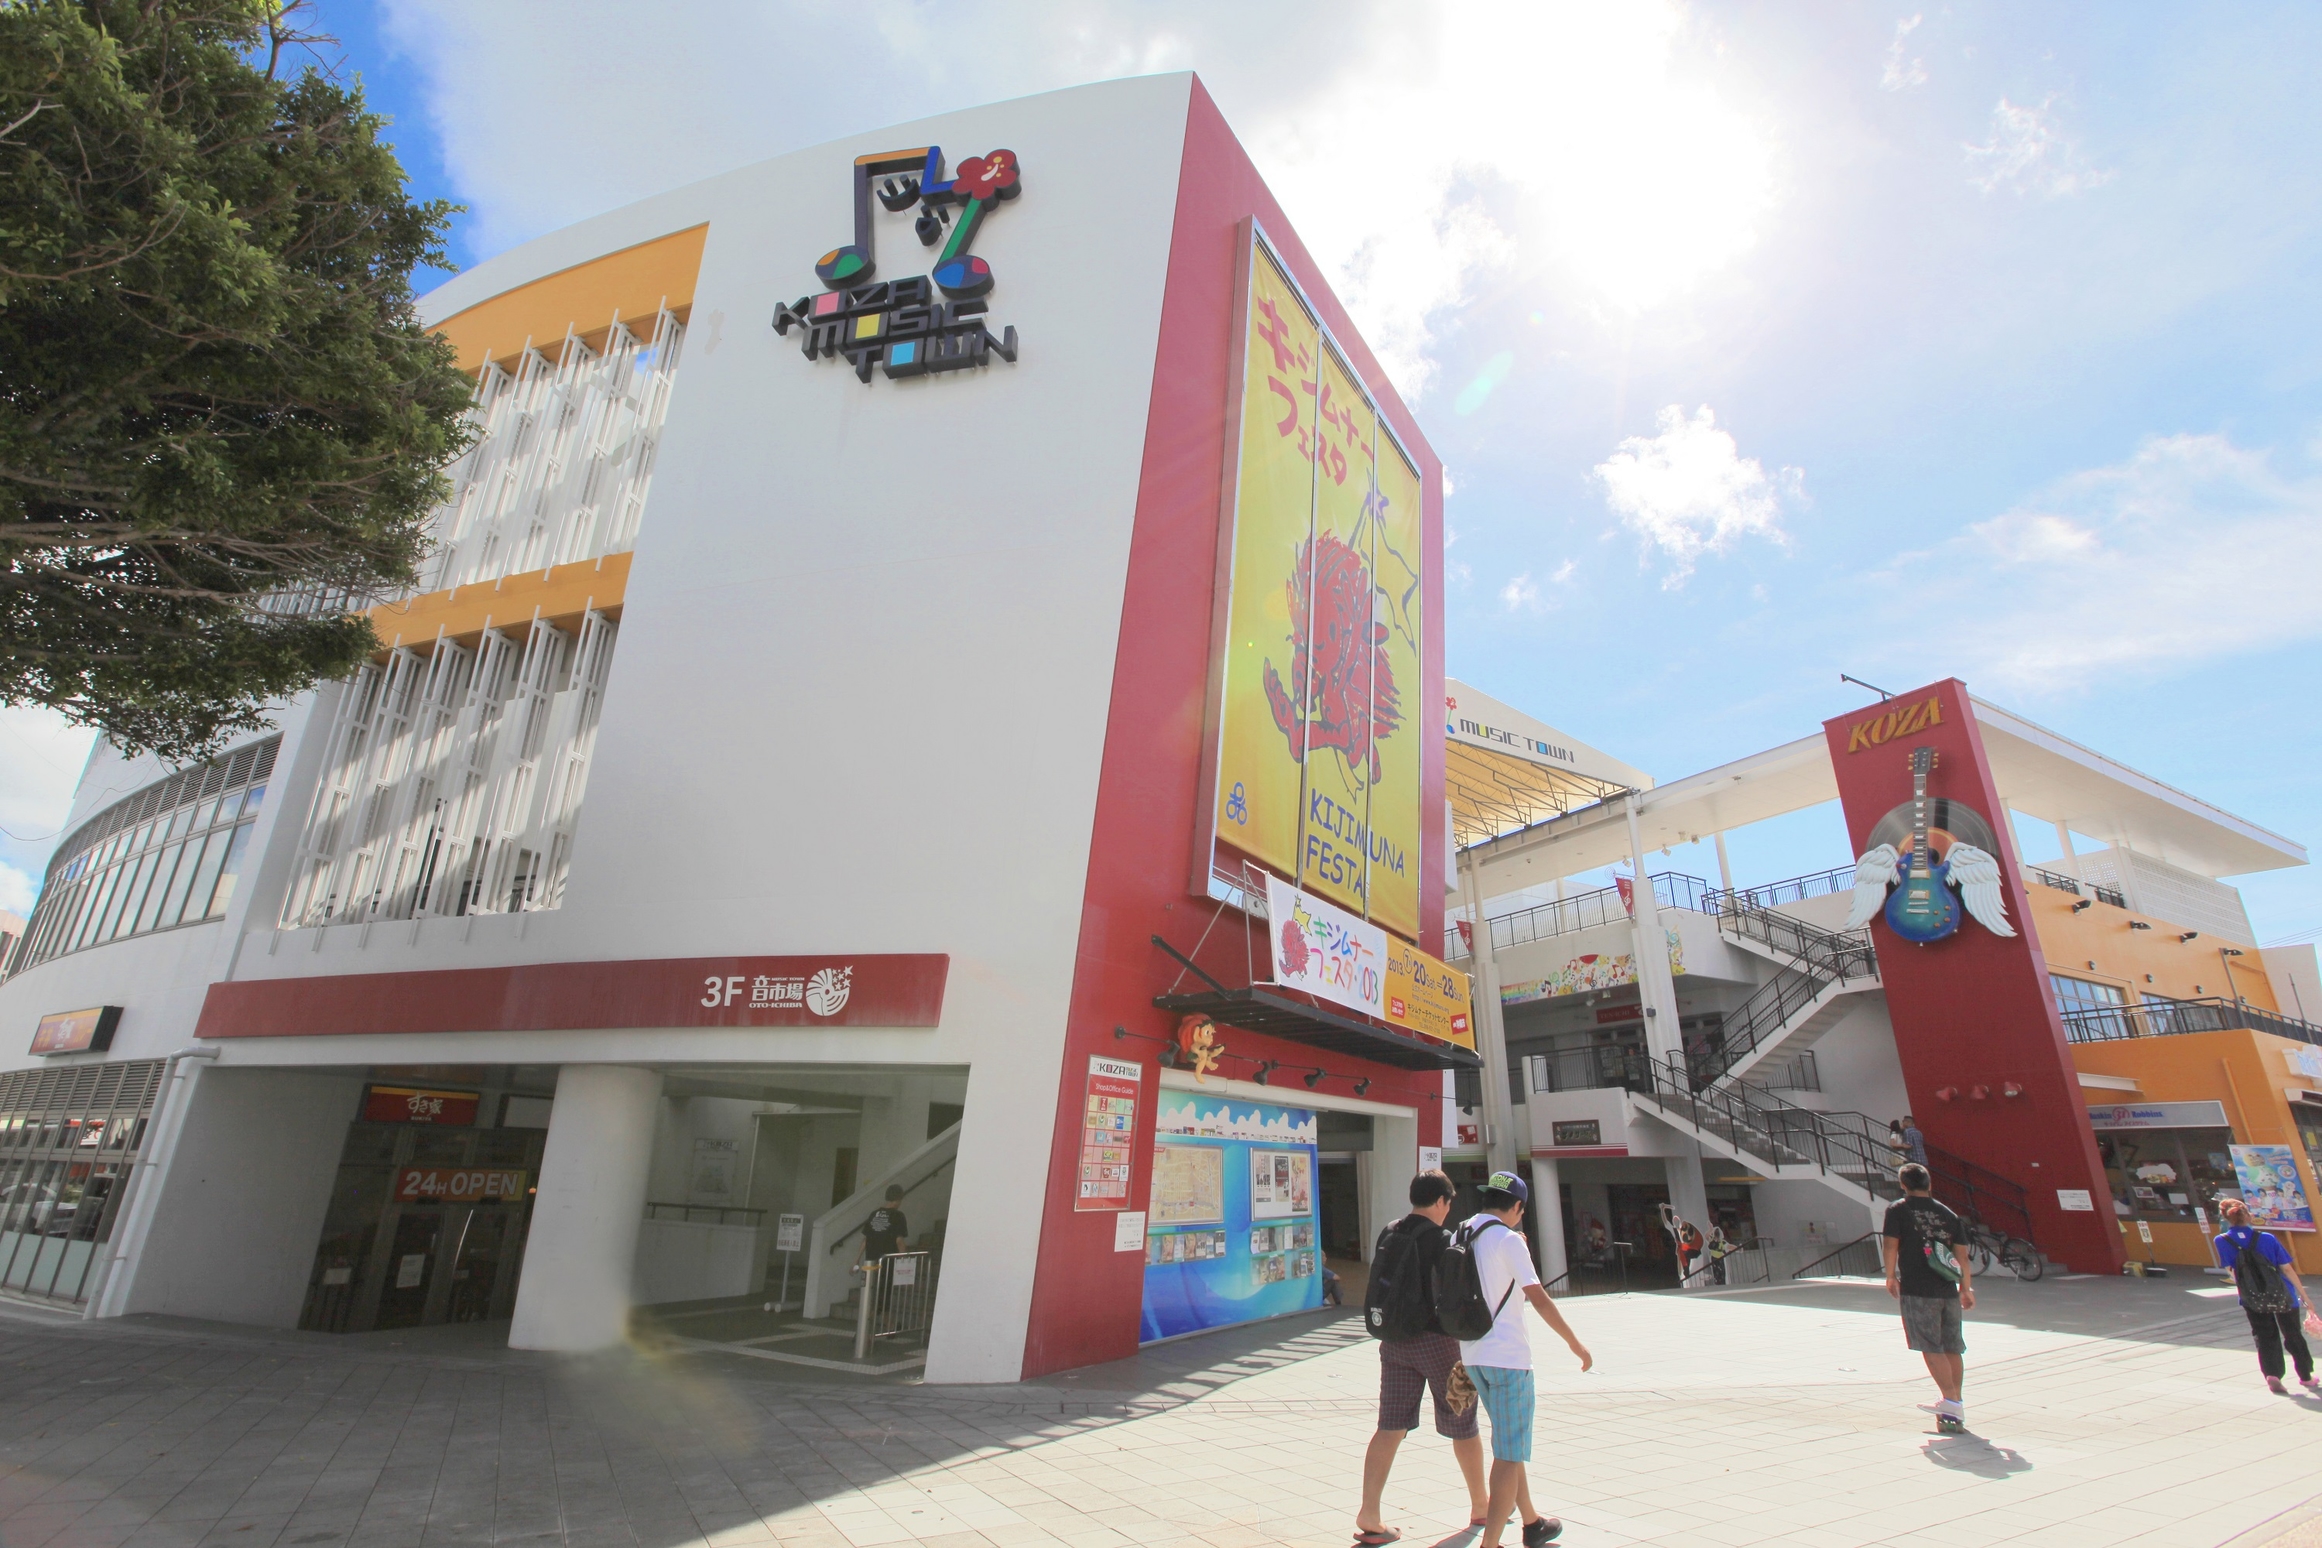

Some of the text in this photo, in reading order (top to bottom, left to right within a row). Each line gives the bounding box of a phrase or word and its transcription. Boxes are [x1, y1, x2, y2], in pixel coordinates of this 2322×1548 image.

[772, 275, 932, 336] KOZA
[802, 299, 988, 361] MUSIC
[844, 324, 1018, 384] TOWN
[1460, 718, 1575, 763] MUSIC TOWN
[1848, 696, 1944, 753] KOZA
[1310, 788, 1405, 879] KIJIMUNA
[1306, 834, 1364, 898] FESTA
[1313, 916, 1374, 962] キジムナー
[700, 976, 745, 1008] 3F
[752, 975, 804, 1001] 音市場
[1100, 1063, 1126, 1075] KOZA
[1121, 1086, 1134, 1095] Guide
[403, 1171, 518, 1195] 24H OPEN
